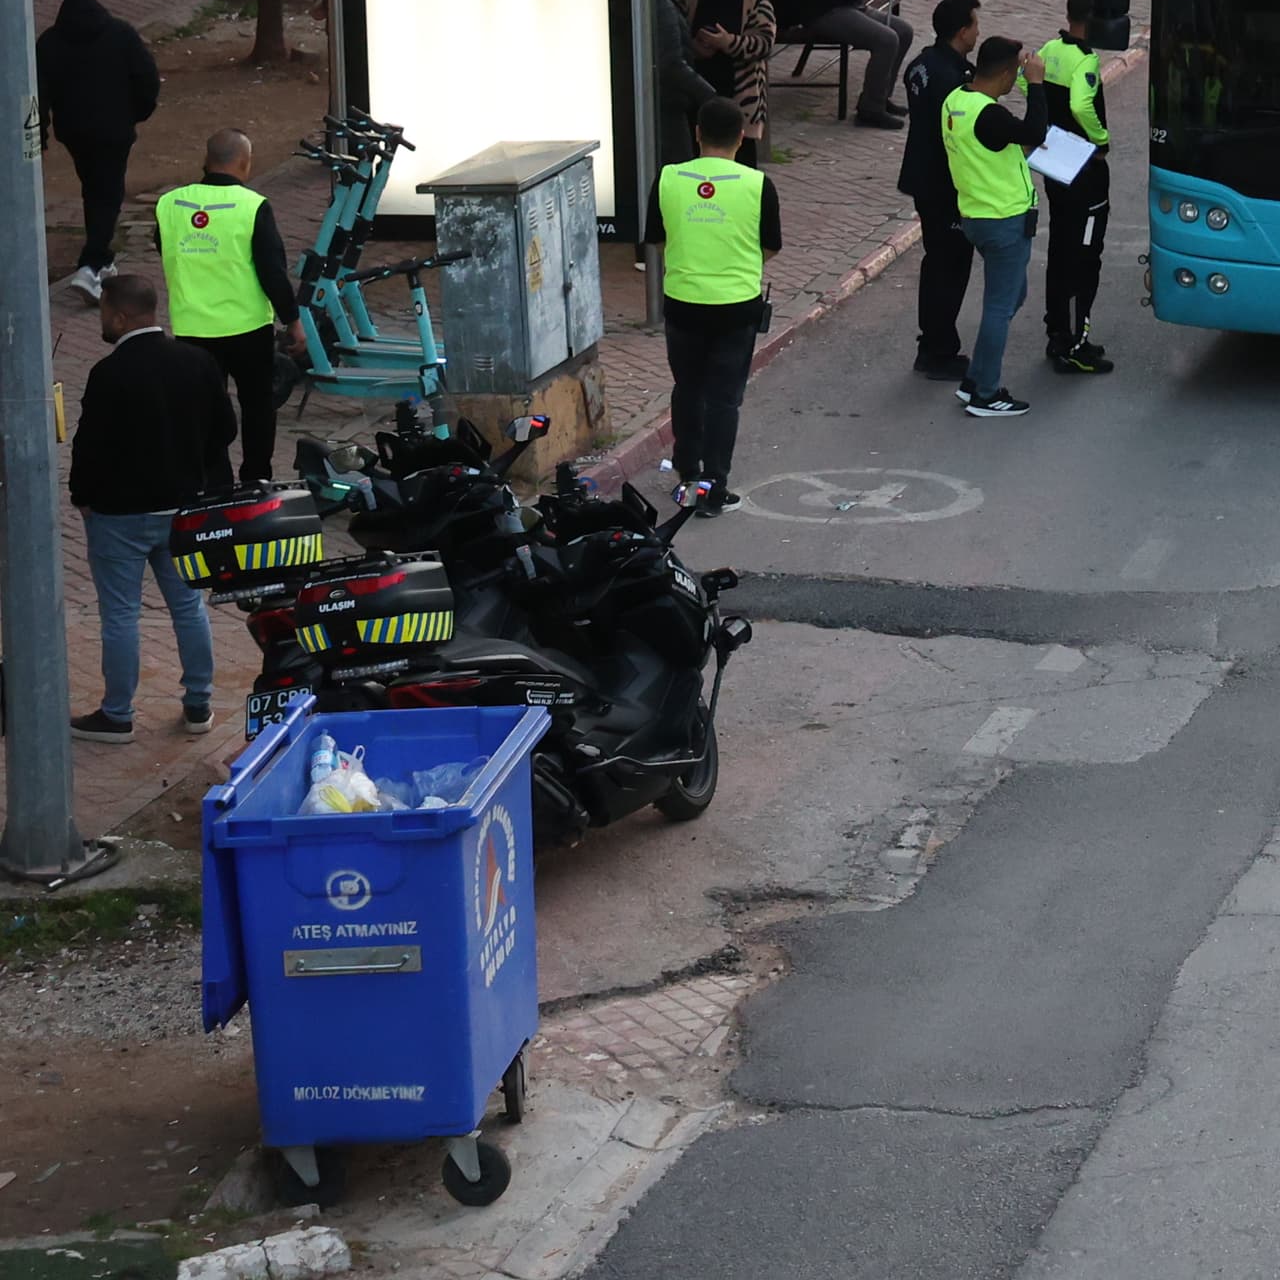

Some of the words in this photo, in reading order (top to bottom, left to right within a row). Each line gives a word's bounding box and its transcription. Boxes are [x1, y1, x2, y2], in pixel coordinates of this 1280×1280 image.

[196, 528, 233, 542] ULAŞIM
[318, 599, 356, 613] ULAŞIM
[250, 695, 272, 714] 07
[292, 924, 332, 941] ATEŞ
[336, 920, 418, 938] ATMAYINIZ
[294, 1086, 340, 1101] MOLOZ
